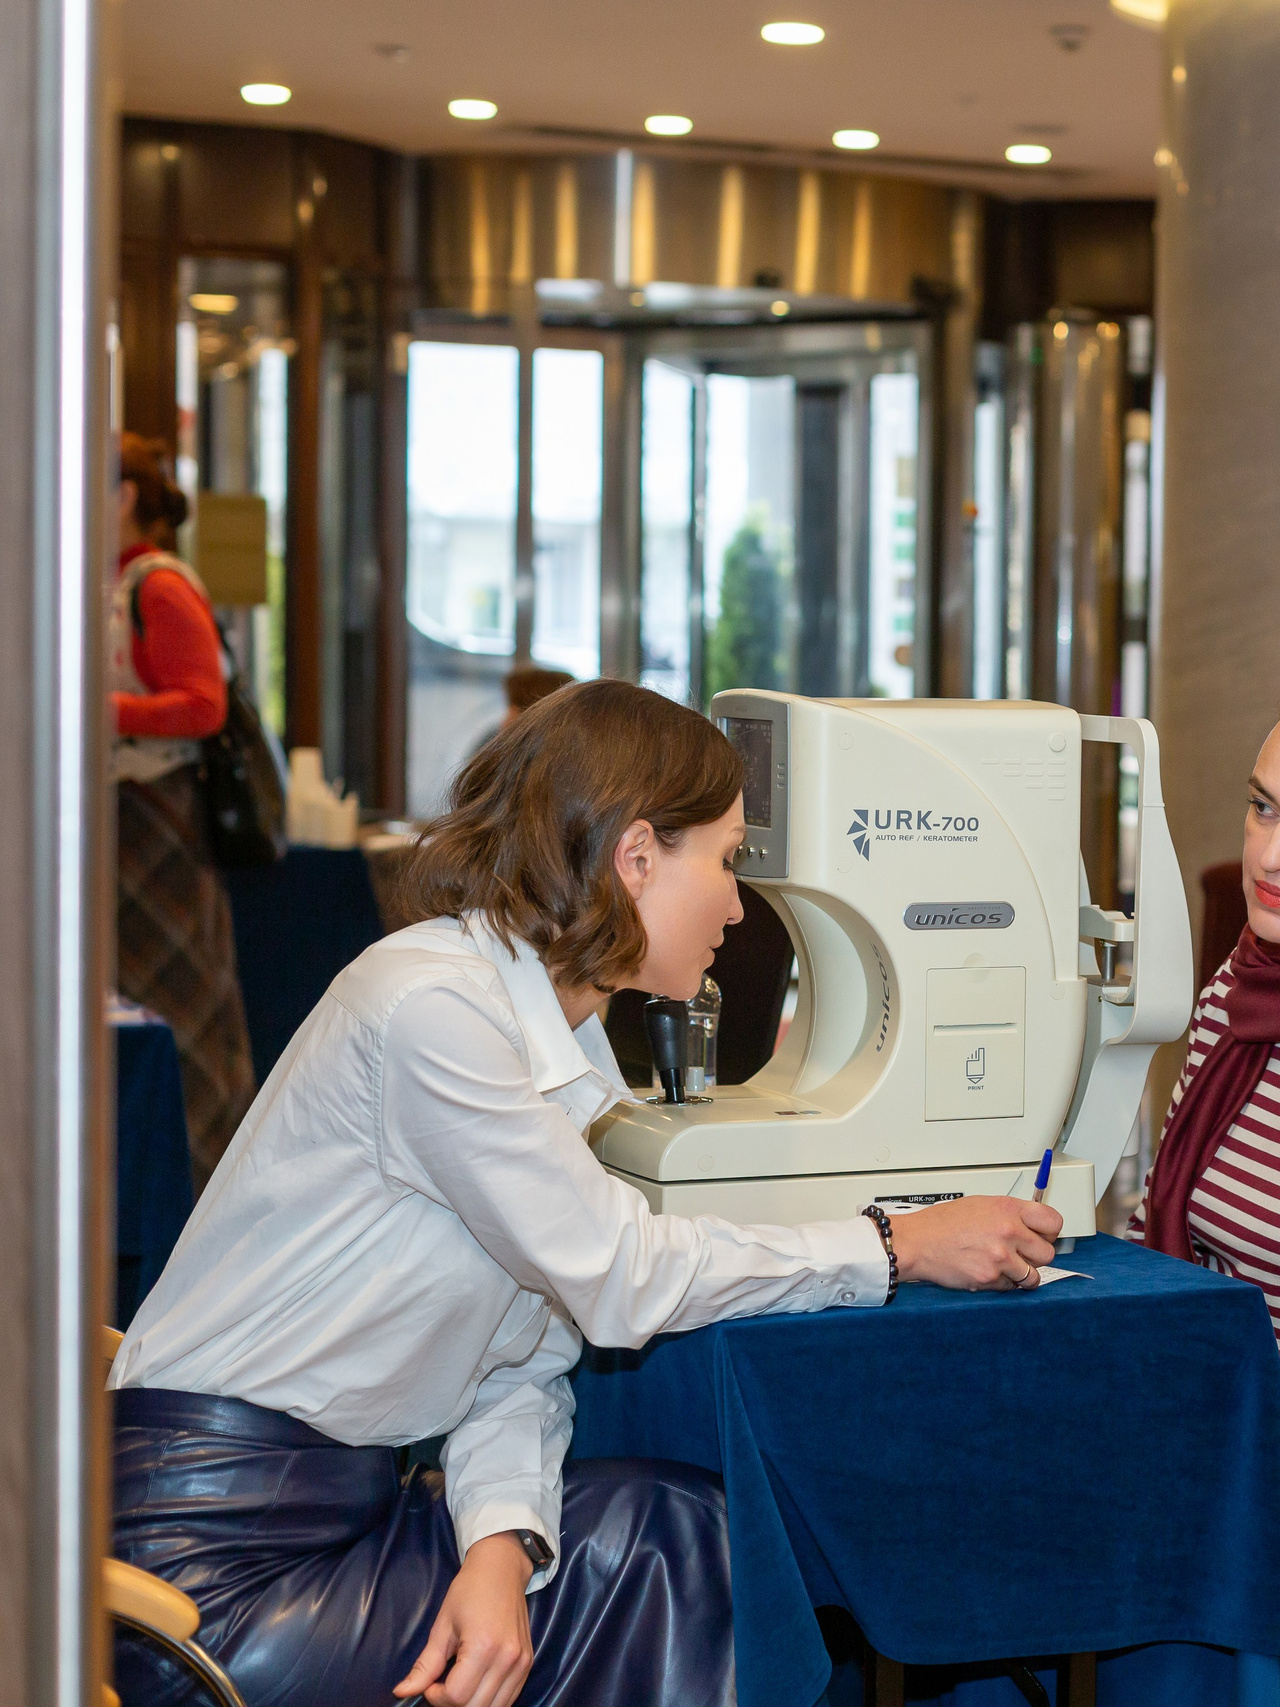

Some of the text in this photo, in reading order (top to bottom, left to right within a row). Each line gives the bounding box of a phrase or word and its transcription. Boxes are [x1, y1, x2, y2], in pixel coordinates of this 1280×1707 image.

[874, 809, 980, 832] URK-700
[914, 908, 1003, 926] unicos
[870, 941, 890, 1053] unicos
